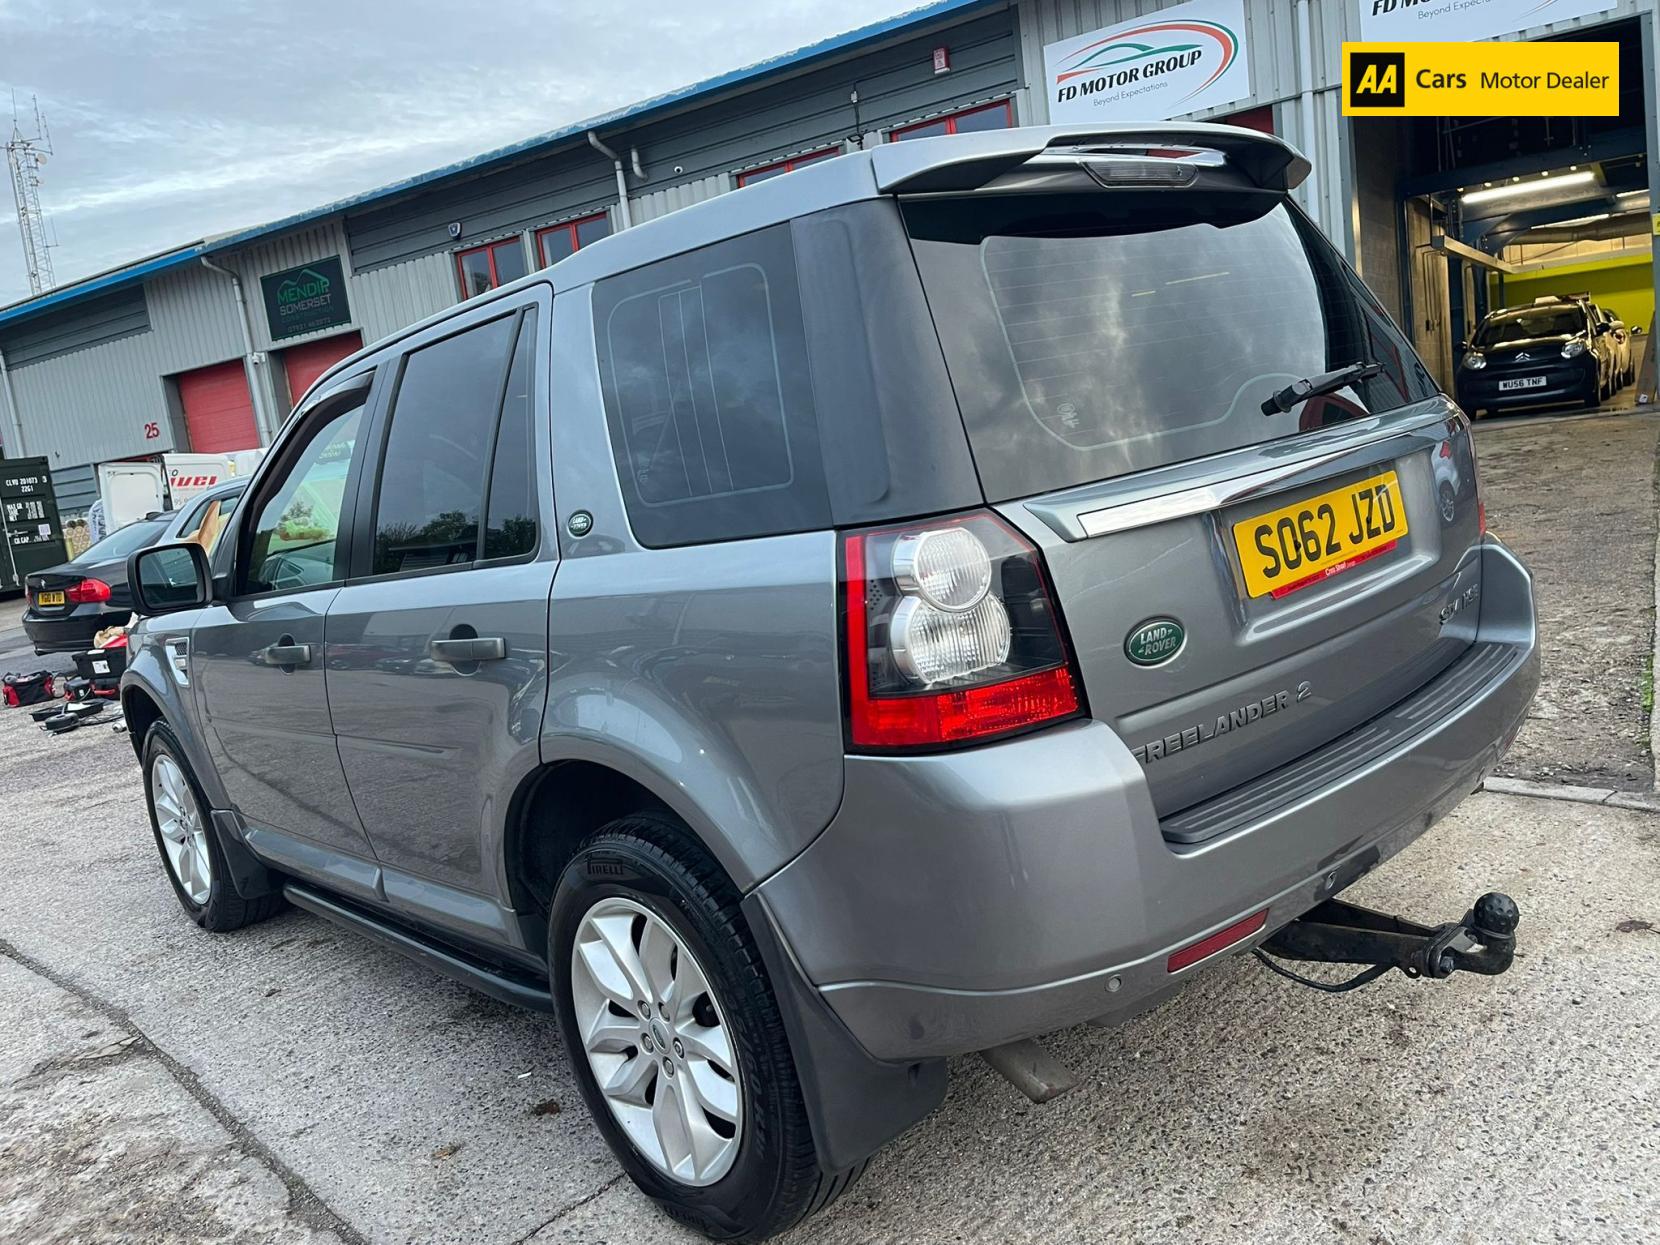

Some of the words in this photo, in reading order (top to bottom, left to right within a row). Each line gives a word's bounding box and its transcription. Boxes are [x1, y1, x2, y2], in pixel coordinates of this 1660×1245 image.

[1372, 0, 1397, 16] FD
[1418, 6, 1450, 20] Beyond
[1057, 85, 1078, 103] FD
[1080, 67, 1140, 97] MOTOR
[1142, 50, 1203, 79] GROUP
[1093, 92, 1120, 107] Beyond
[1121, 81, 1169, 101] Expectations
[277, 280, 330, 305] MENDIP
[280, 293, 331, 316] SOMERSET
[1503, 380, 1525, 389] WU56
[144, 422, 160, 439] 25
[1254, 503, 1342, 579] SO62
[1349, 484, 1396, 545] JZD
[1296, 681, 1312, 703] 2
